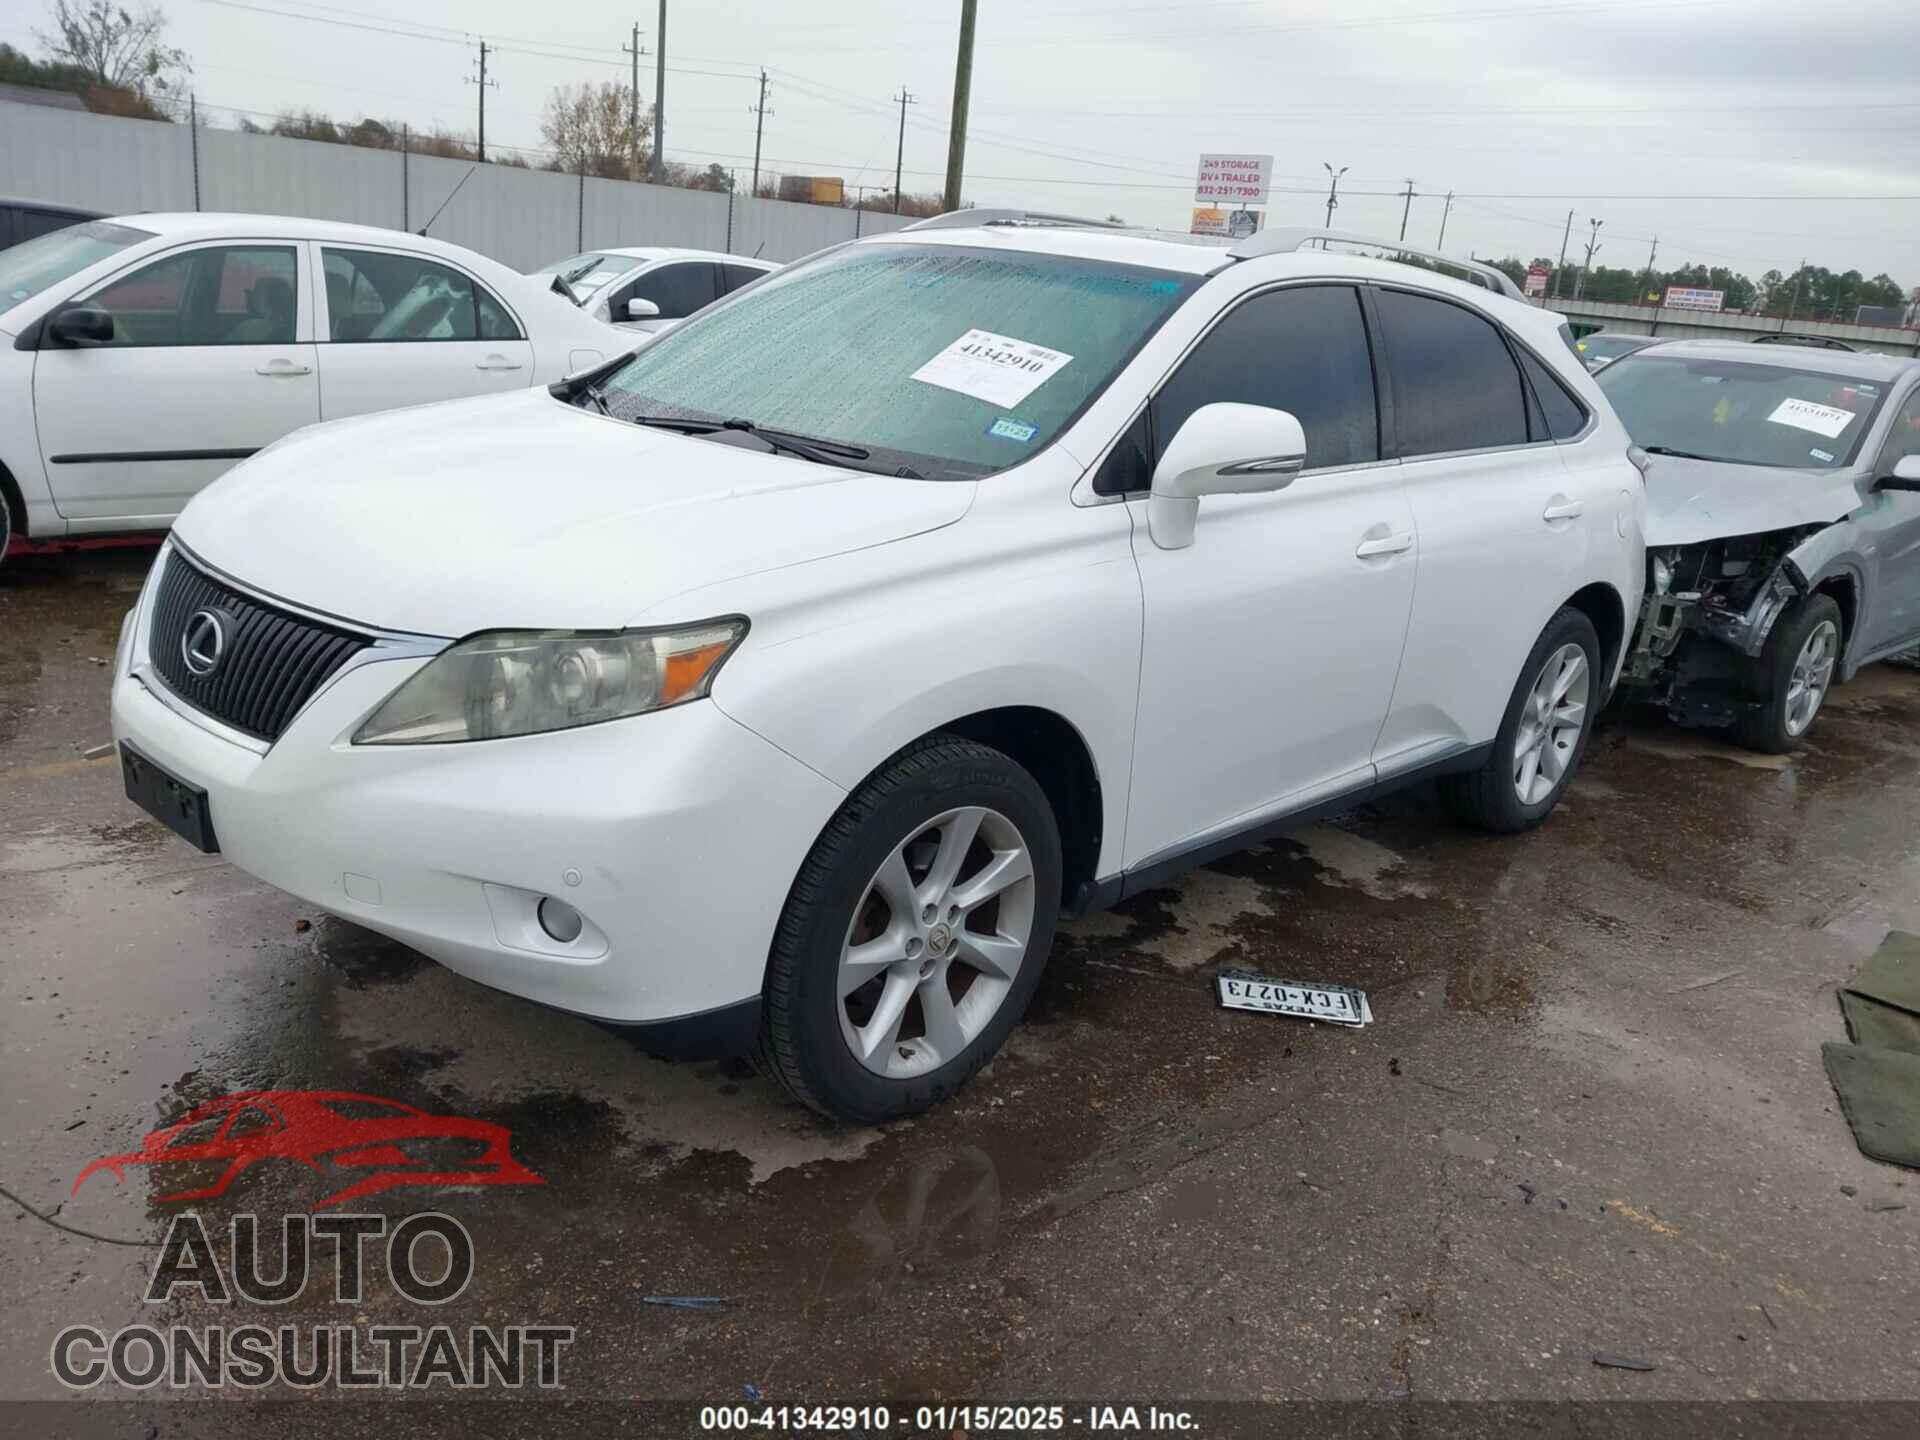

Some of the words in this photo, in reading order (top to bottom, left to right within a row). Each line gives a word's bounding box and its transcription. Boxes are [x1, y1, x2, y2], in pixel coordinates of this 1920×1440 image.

[1203, 160, 1219, 168] 249
[1221, 160, 1260, 169] STORAGE
[1200, 173, 1214, 181] RV
[1221, 173, 1260, 183] TRAILER
[961, 343, 1044, 373] 41342910
[1262, 1002, 1313, 1014] TEXAS
